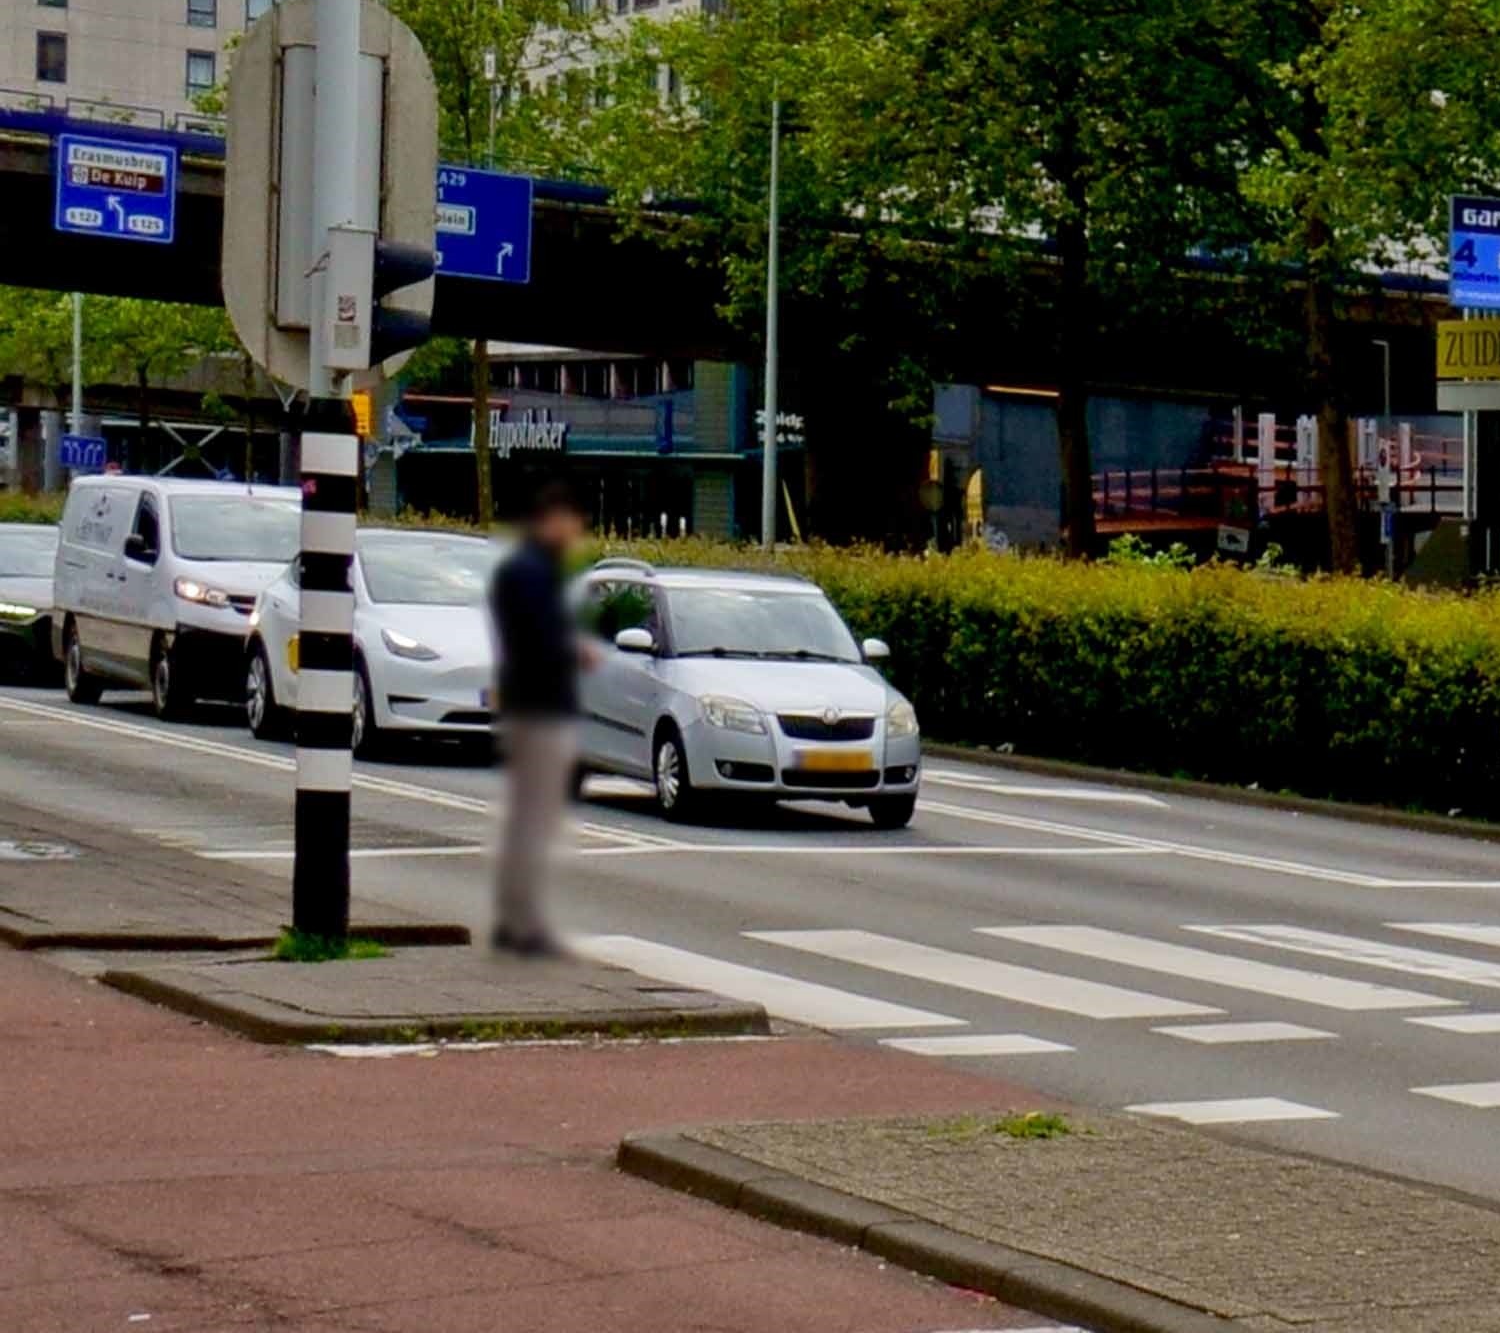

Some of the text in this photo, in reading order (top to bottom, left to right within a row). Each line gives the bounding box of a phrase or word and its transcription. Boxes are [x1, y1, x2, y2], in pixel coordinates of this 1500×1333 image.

[72, 147, 163, 173] Erasmusbrug
[91, 167, 147, 190] De Kuip
[439, 171, 467, 187] A29
[1453, 238, 1477, 269] 4
[488, 408, 566, 459] Hypotheker
